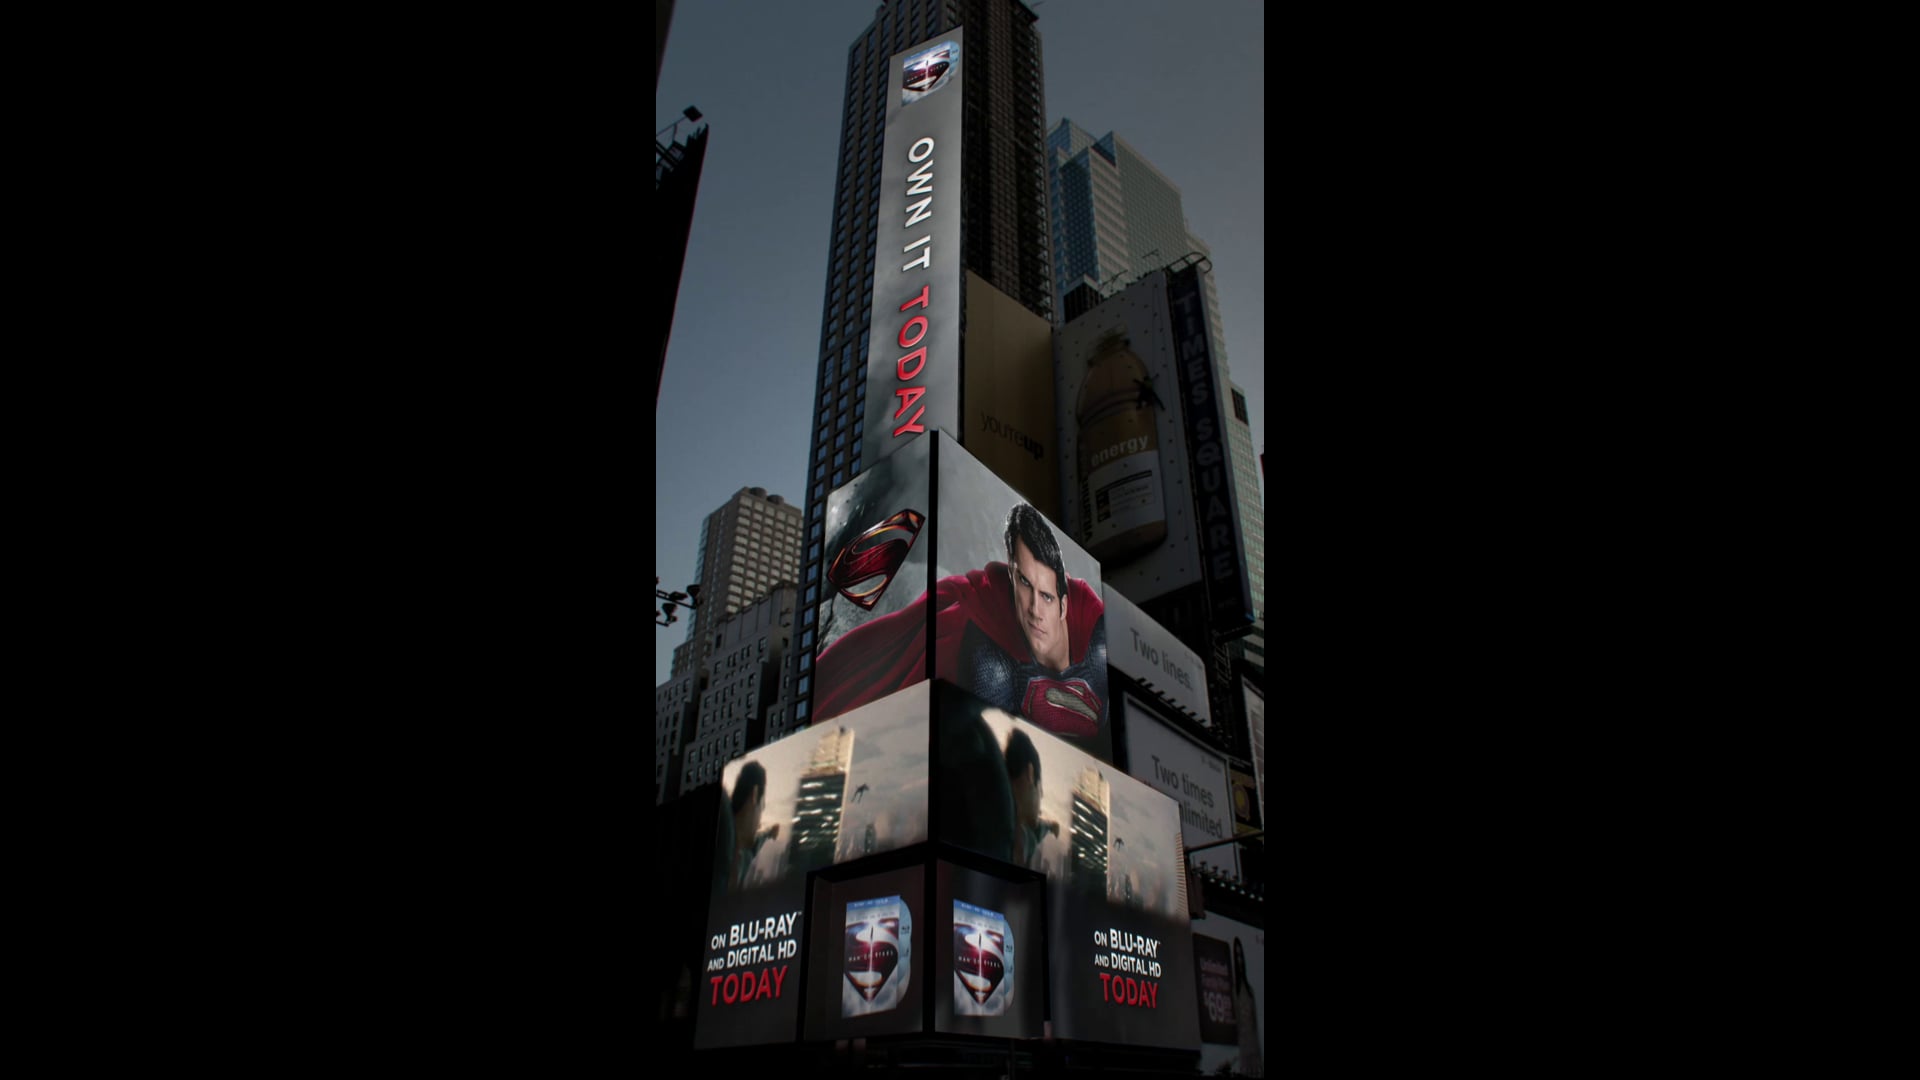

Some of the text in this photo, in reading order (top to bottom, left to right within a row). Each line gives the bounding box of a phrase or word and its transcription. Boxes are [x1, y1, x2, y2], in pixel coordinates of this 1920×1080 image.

[893, 136, 935, 437] OWN IT TODAY
[1090, 435, 1149, 467] energy
[1173, 291, 1209, 406] TIMES
[1195, 416, 1235, 582] SQUARE
[1130, 627, 1159, 665] Two
[1152, 755, 1179, 789] Two
[1182, 773, 1214, 808] times
[707, 939, 797, 972] AND DIGITAL HD
[711, 933, 727, 950] ON
[1093, 930, 1108, 947] ON
[1094, 952, 1162, 978] AND DIGITAL HD
[710, 965, 789, 1007] TODAY
[1099, 972, 1159, 1008] TODAY
